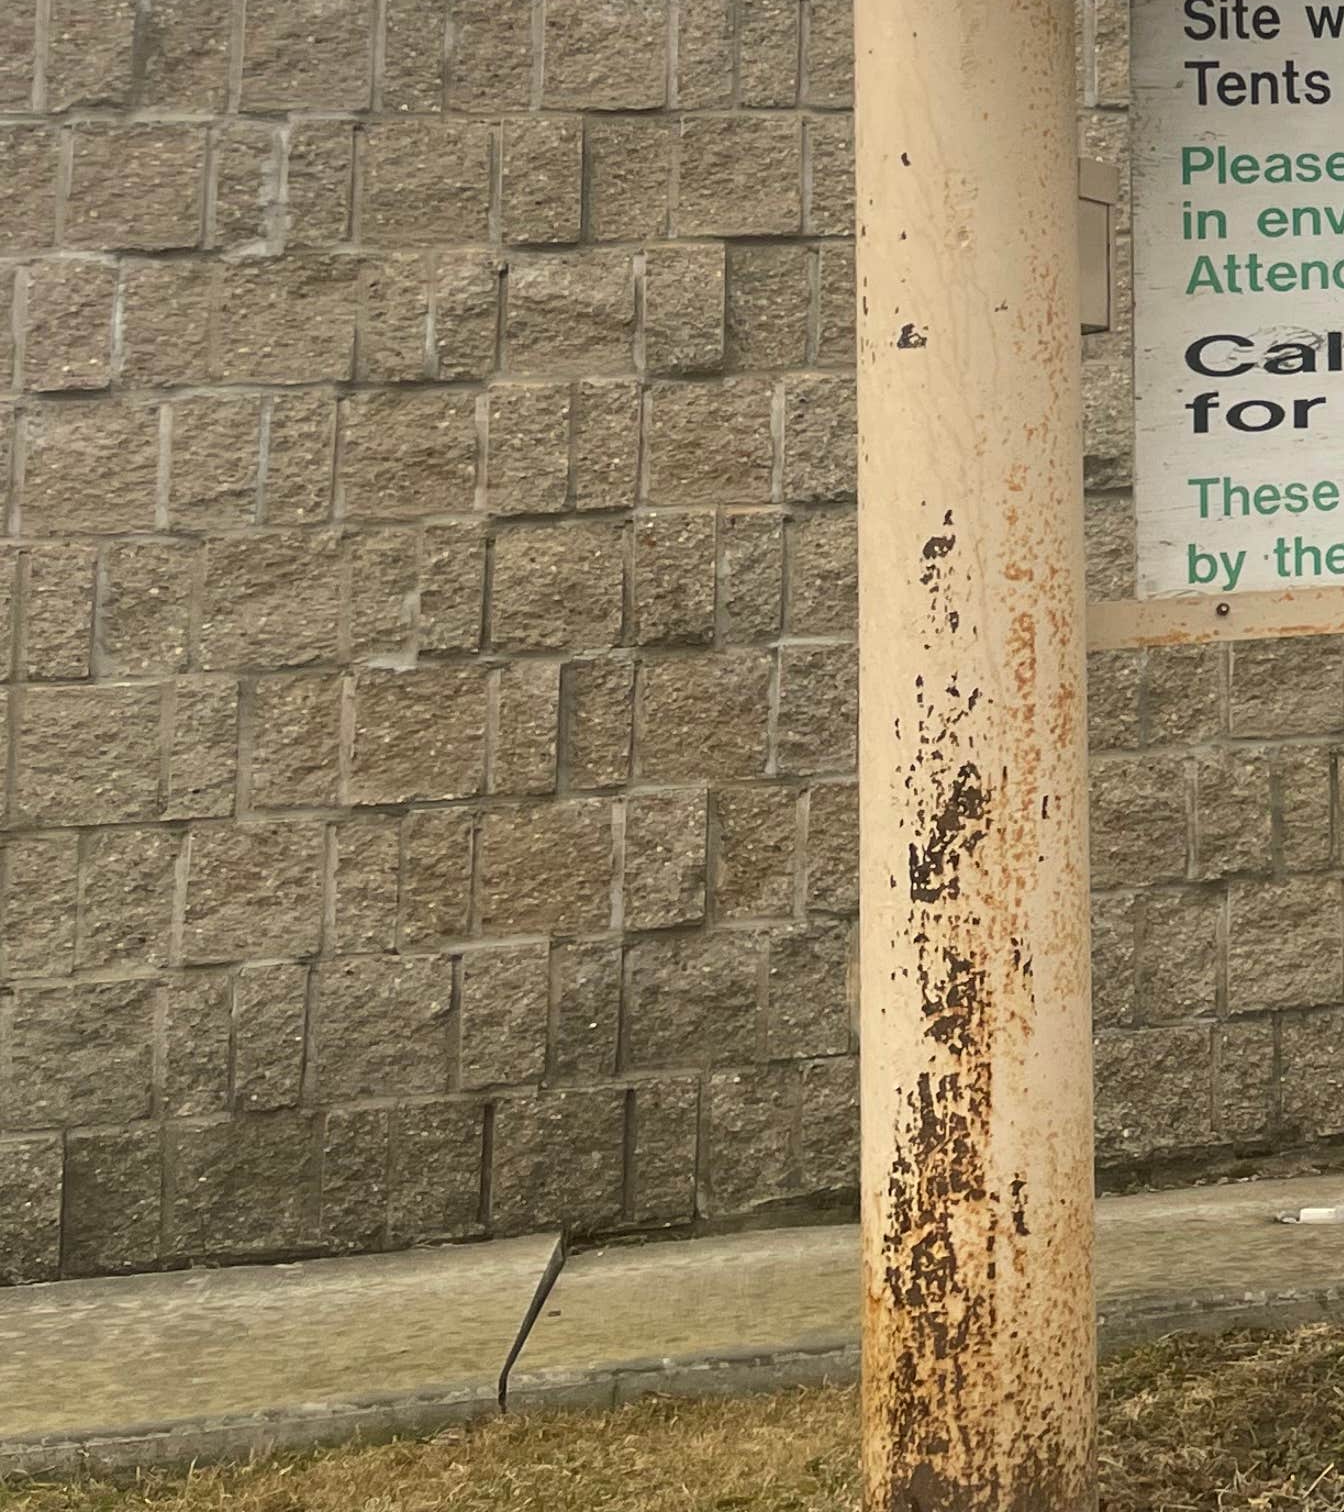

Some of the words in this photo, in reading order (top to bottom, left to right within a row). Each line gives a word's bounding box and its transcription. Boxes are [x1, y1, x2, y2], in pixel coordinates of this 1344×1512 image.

[1184, 60, 1331, 106] Tents
[1183, 201, 1227, 240] in
[1185, 391, 1326, 433] for
[1188, 477, 1339, 518] These
[1188, 543, 1247, 591] by
